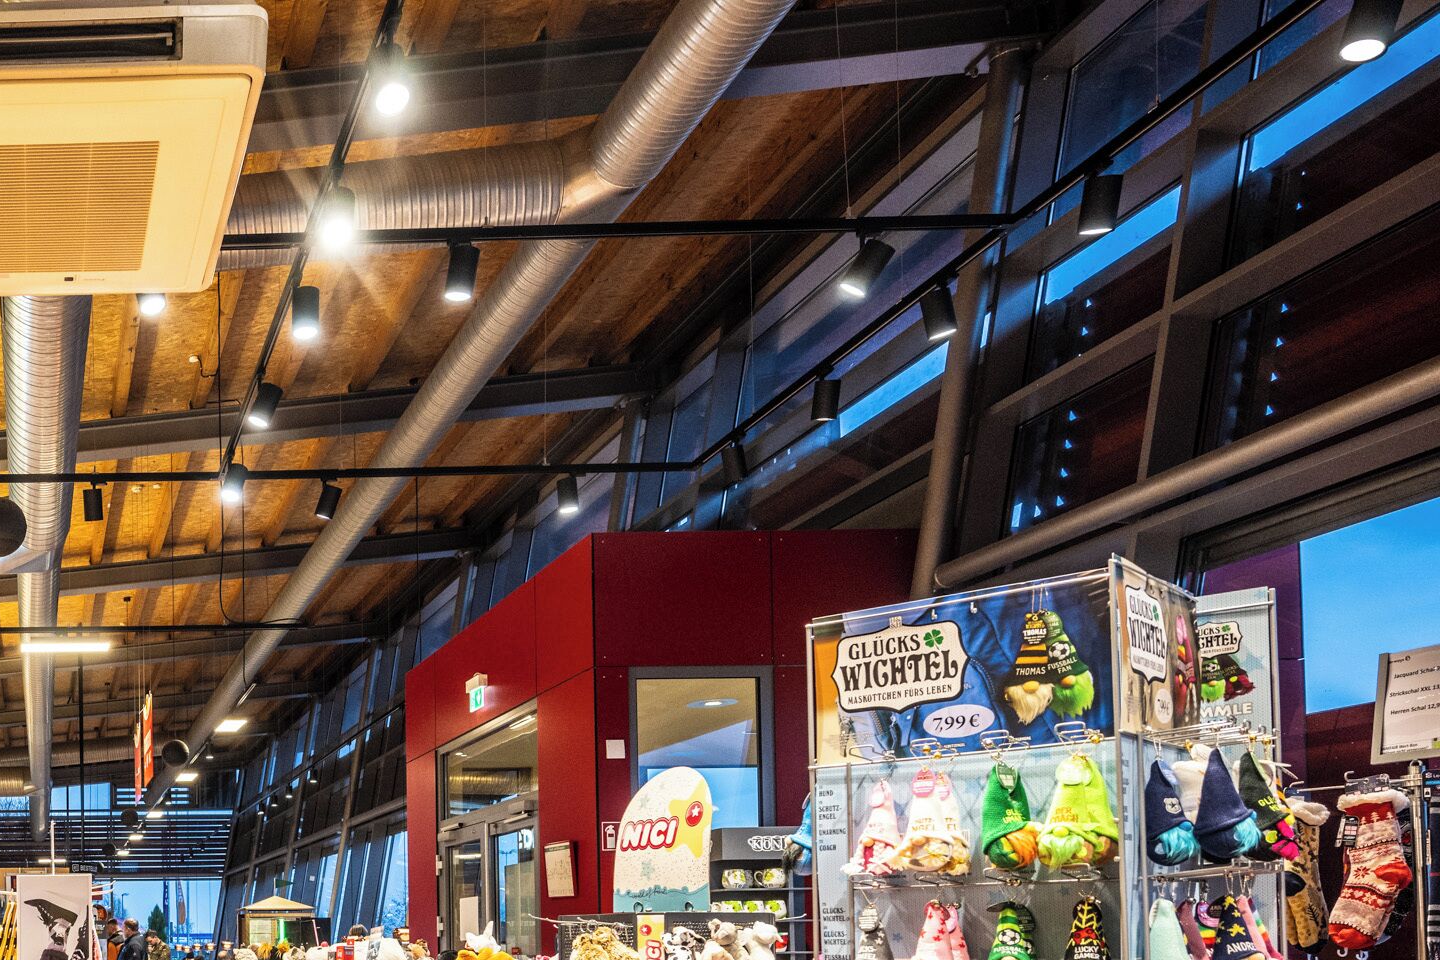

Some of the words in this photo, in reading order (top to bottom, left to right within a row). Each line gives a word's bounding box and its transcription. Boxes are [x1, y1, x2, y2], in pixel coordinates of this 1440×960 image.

[1128, 617, 1165, 660] WICHTEL
[849, 634, 921, 660] GLÜCKS
[1047, 656, 1077, 671] FUSSBALL
[840, 650, 958, 692] WICHTEL
[1016, 666, 1046, 676] THOMAS
[1057, 665, 1072, 674] FAN
[1394, 670, 1418, 679] Jacquard
[848, 690, 902, 705] MASKOTTCHEN
[904, 687, 924, 698] FÜRS
[926, 684, 952, 695] LEBEN
[1389, 687, 1419, 697] Strickschal
[1201, 703, 1252, 718] MMLE
[1411, 705, 1427, 713] Schal
[932, 715, 966, 732] 7,99
[970, 714, 980, 727] €
[819, 812, 836, 820] ENGEL
[620, 816, 679, 852] NICI
[822, 914, 846, 922] WICHTEL
[824, 937, 847, 945] WICHTEL
[1074, 946, 1099, 954] LUCKY
[1073, 952, 1100, 960] GAMER
